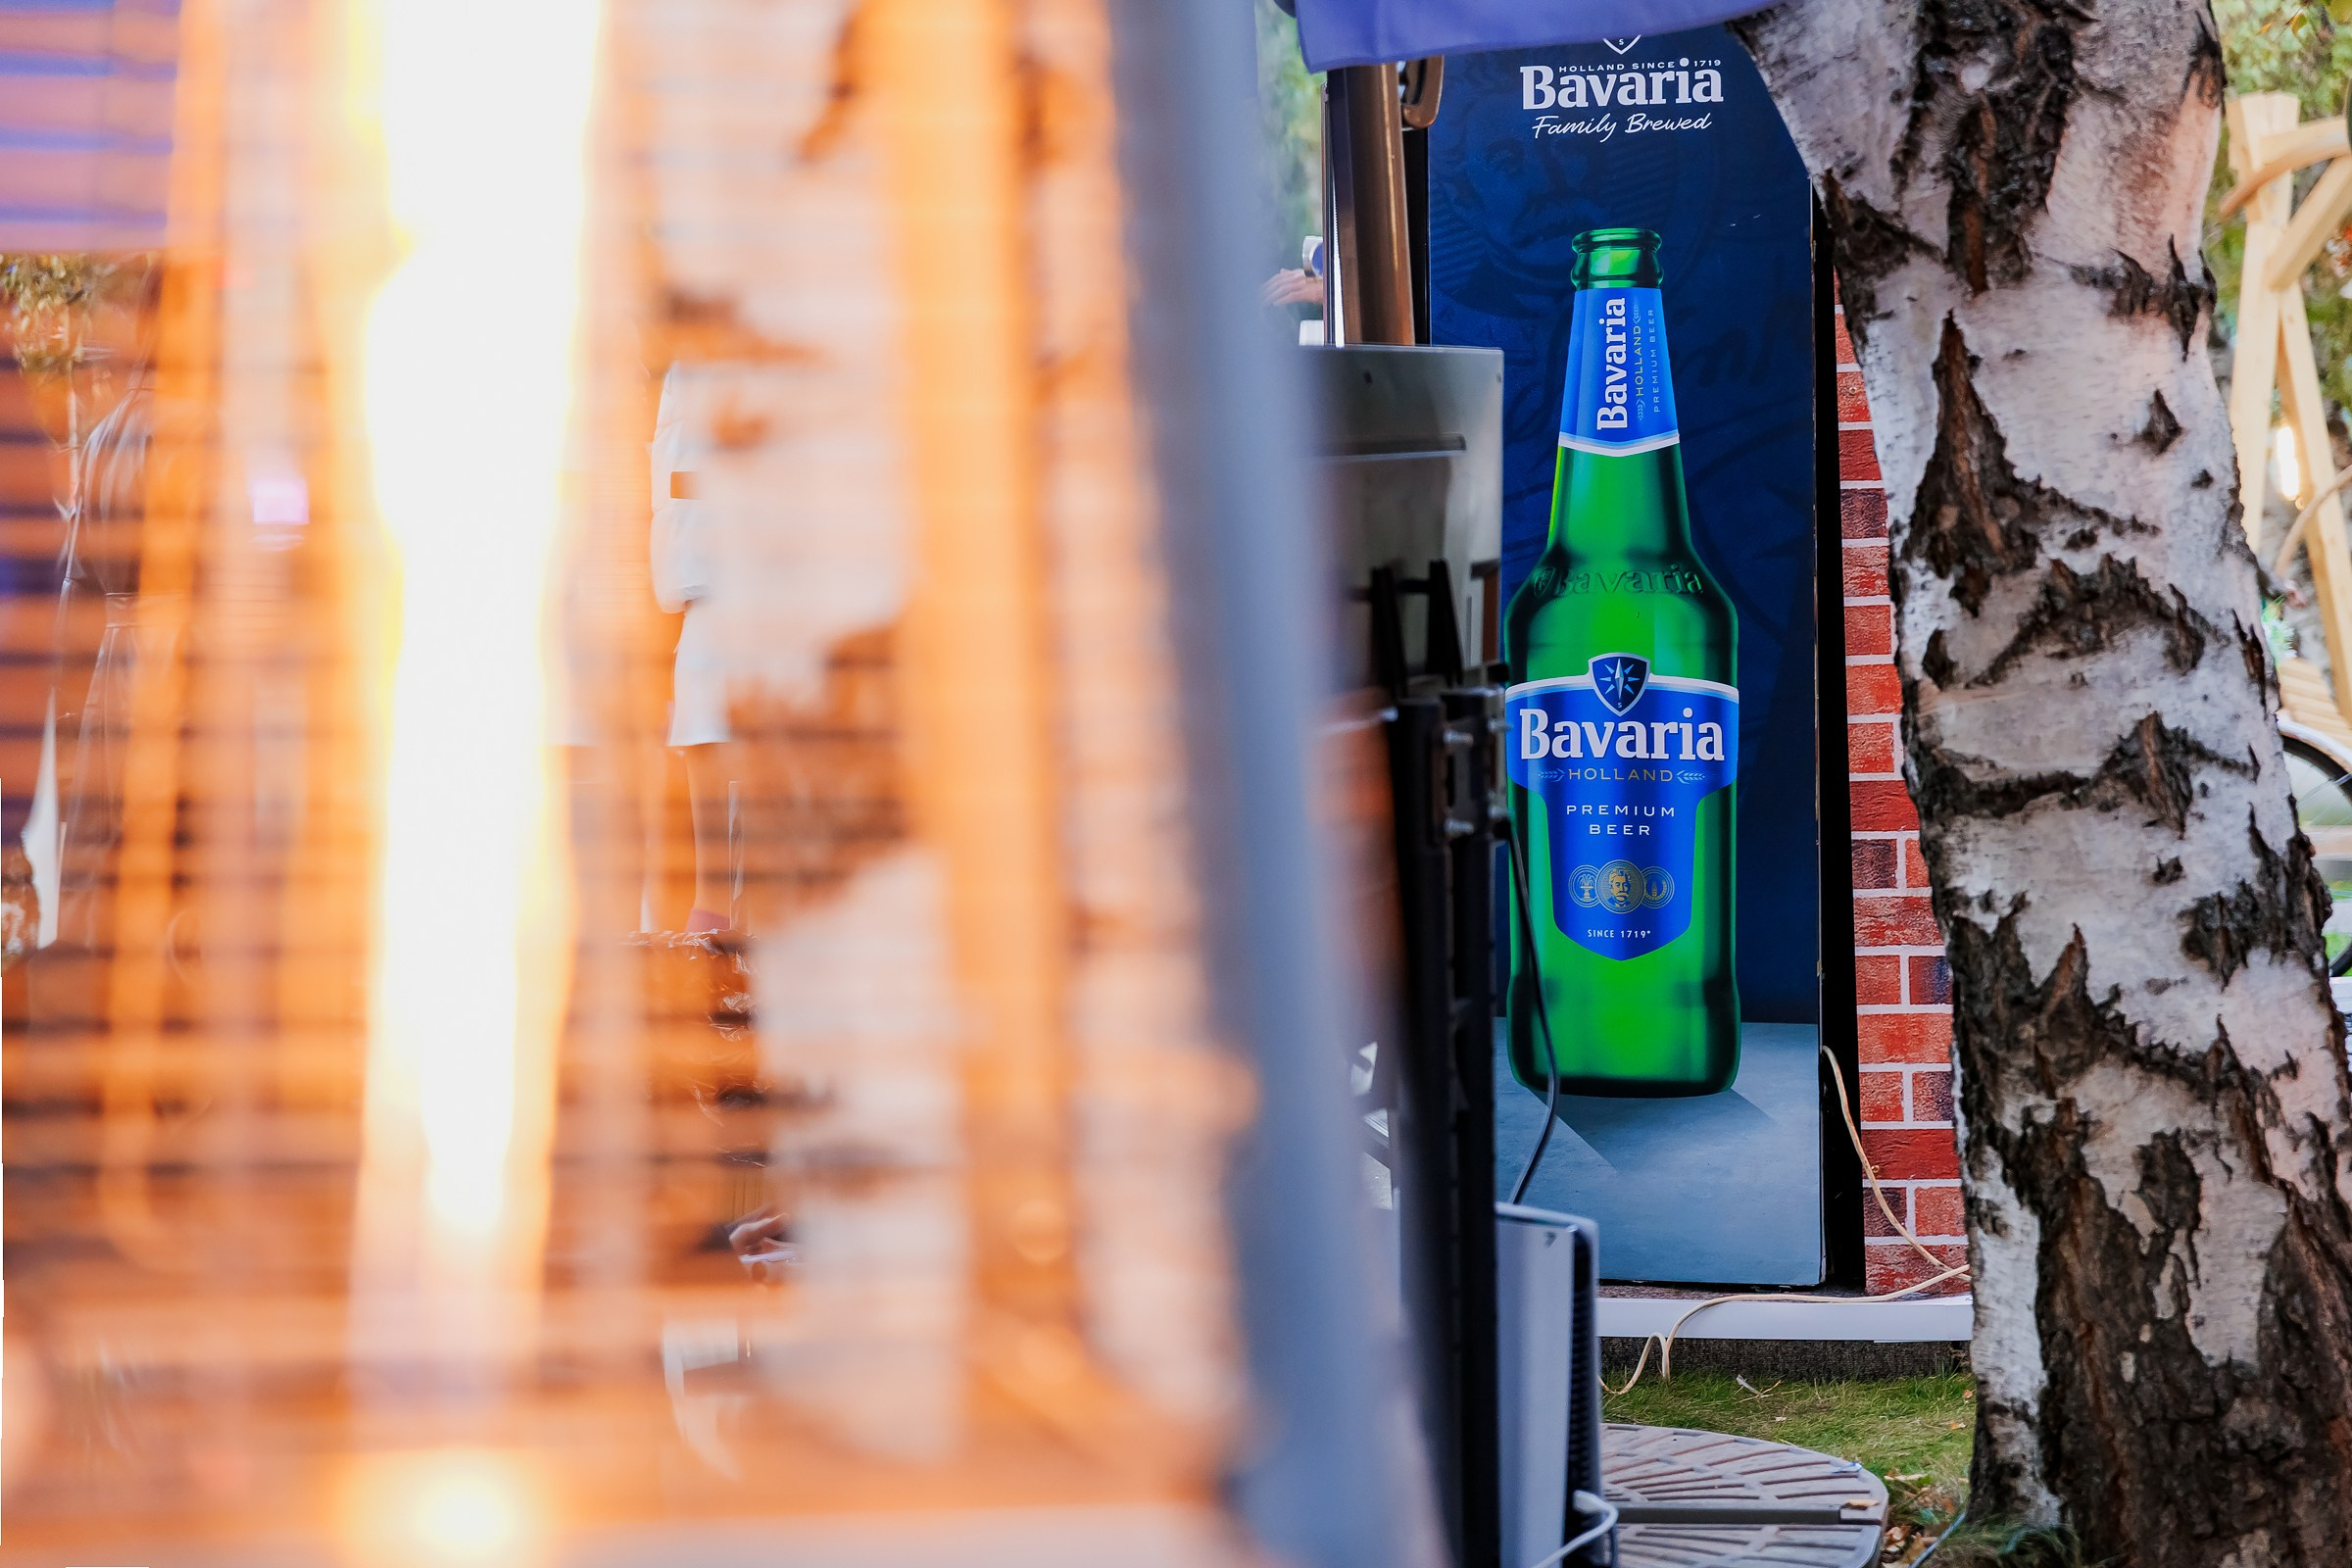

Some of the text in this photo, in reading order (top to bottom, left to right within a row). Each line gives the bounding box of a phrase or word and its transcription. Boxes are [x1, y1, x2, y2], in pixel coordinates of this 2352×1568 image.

[1558, 59, 1722, 74] HOLLAND SINCE 1719
[1520, 57, 1725, 110] Bavaria
[1532, 112, 1713, 143] Family Brewed
[1596, 297, 1628, 430] Bavaria
[1633, 325, 1644, 397] HOLLAND
[1647, 309, 1660, 413] PREMIUM BEER
[1553, 564, 1704, 596] Bavaria
[1519, 707, 1725, 761] Bavaria
[1568, 767, 1673, 782] HOLLAND
[1566, 805, 1675, 817] PREMIUM
[1589, 824, 1650, 836] BEER
[1587, 929, 1615, 938] SINCE
